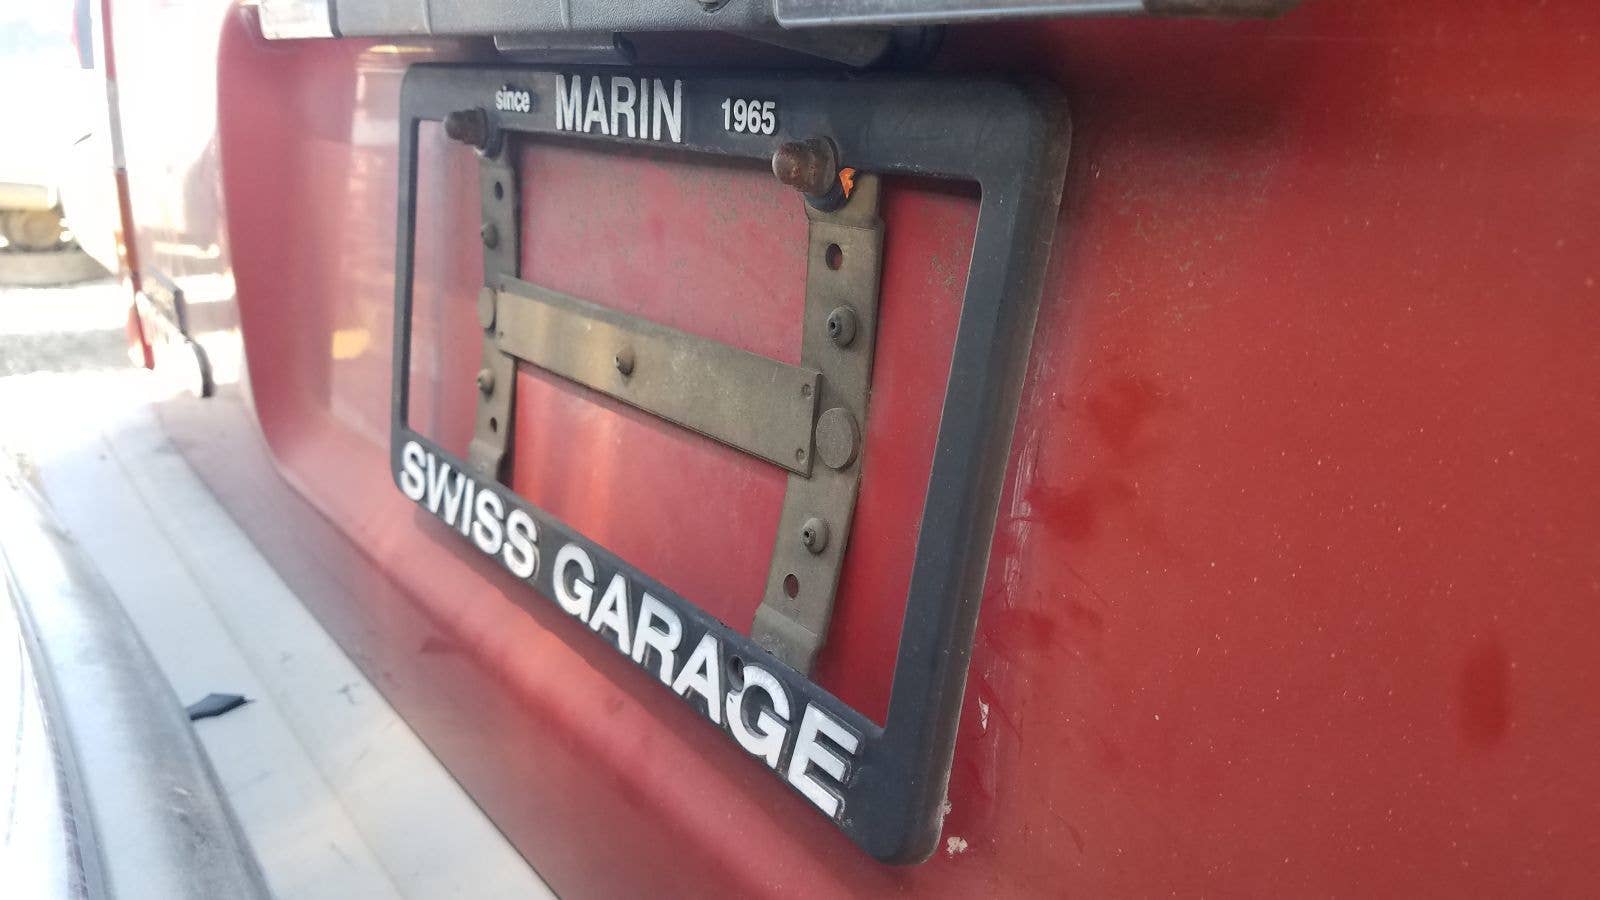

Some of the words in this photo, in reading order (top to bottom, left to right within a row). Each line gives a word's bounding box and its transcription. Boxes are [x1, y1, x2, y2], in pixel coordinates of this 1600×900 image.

[495, 86, 531, 113] since
[555, 74, 683, 143] MARIN
[721, 97, 776, 135] 1965
[399, 440, 538, 579] SWISS
[552, 543, 859, 818] GARAGE
